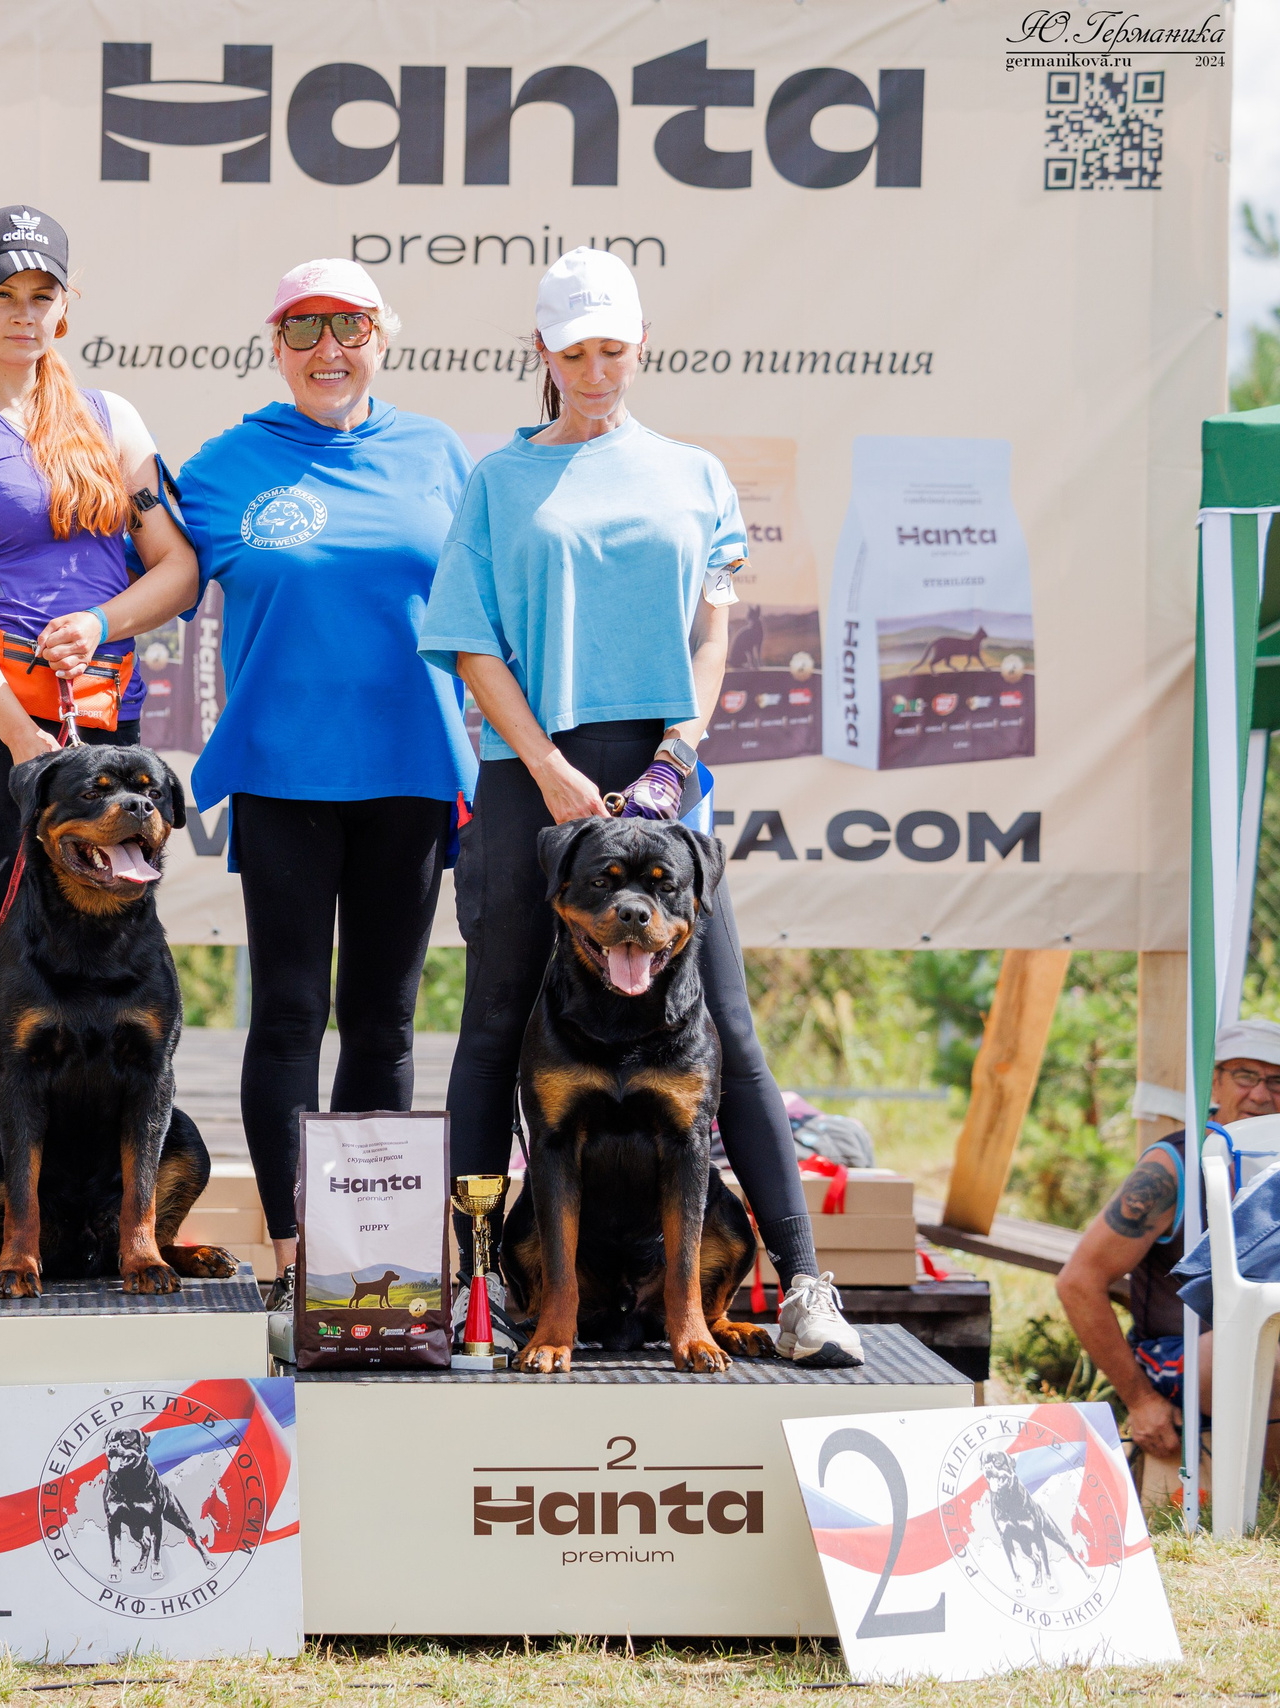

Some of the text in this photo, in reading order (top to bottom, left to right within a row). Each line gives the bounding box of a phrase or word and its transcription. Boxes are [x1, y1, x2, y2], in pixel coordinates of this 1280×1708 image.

[100, 38, 926, 189] Hanta
[2, 228, 49, 245] adidas
[569, 290, 612, 310] FILA
[81, 335, 265, 379] Философ
[742, 349, 934, 375] питания
[257, 488, 285, 502] DOMA
[251, 530, 313, 547] ROTTWEILER
[897, 525, 997, 545] Hanta
[843, 620, 860, 748] Hanta
[329, 1174, 422, 1194] Hanta
[357, 1194, 394, 1203] premium
[359, 1224, 390, 1232] PUPPY
[606, 1435, 637, 1470] 2
[43, 1395, 263, 1562] РОТВЕЙЛЕР КЛУБ РОССИИ
[473, 1480, 764, 1536] Hanta
[942, 1419, 1122, 1580] РОТВЕЙЛЕР КЛУБ РОССИИ
[817, 1427, 946, 1640] 2
[562, 1545, 675, 1566] premium
[98, 1578, 221, 1616] РКФ-НКПР
[1012, 1591, 1103, 1628] РКФ-НКПР
